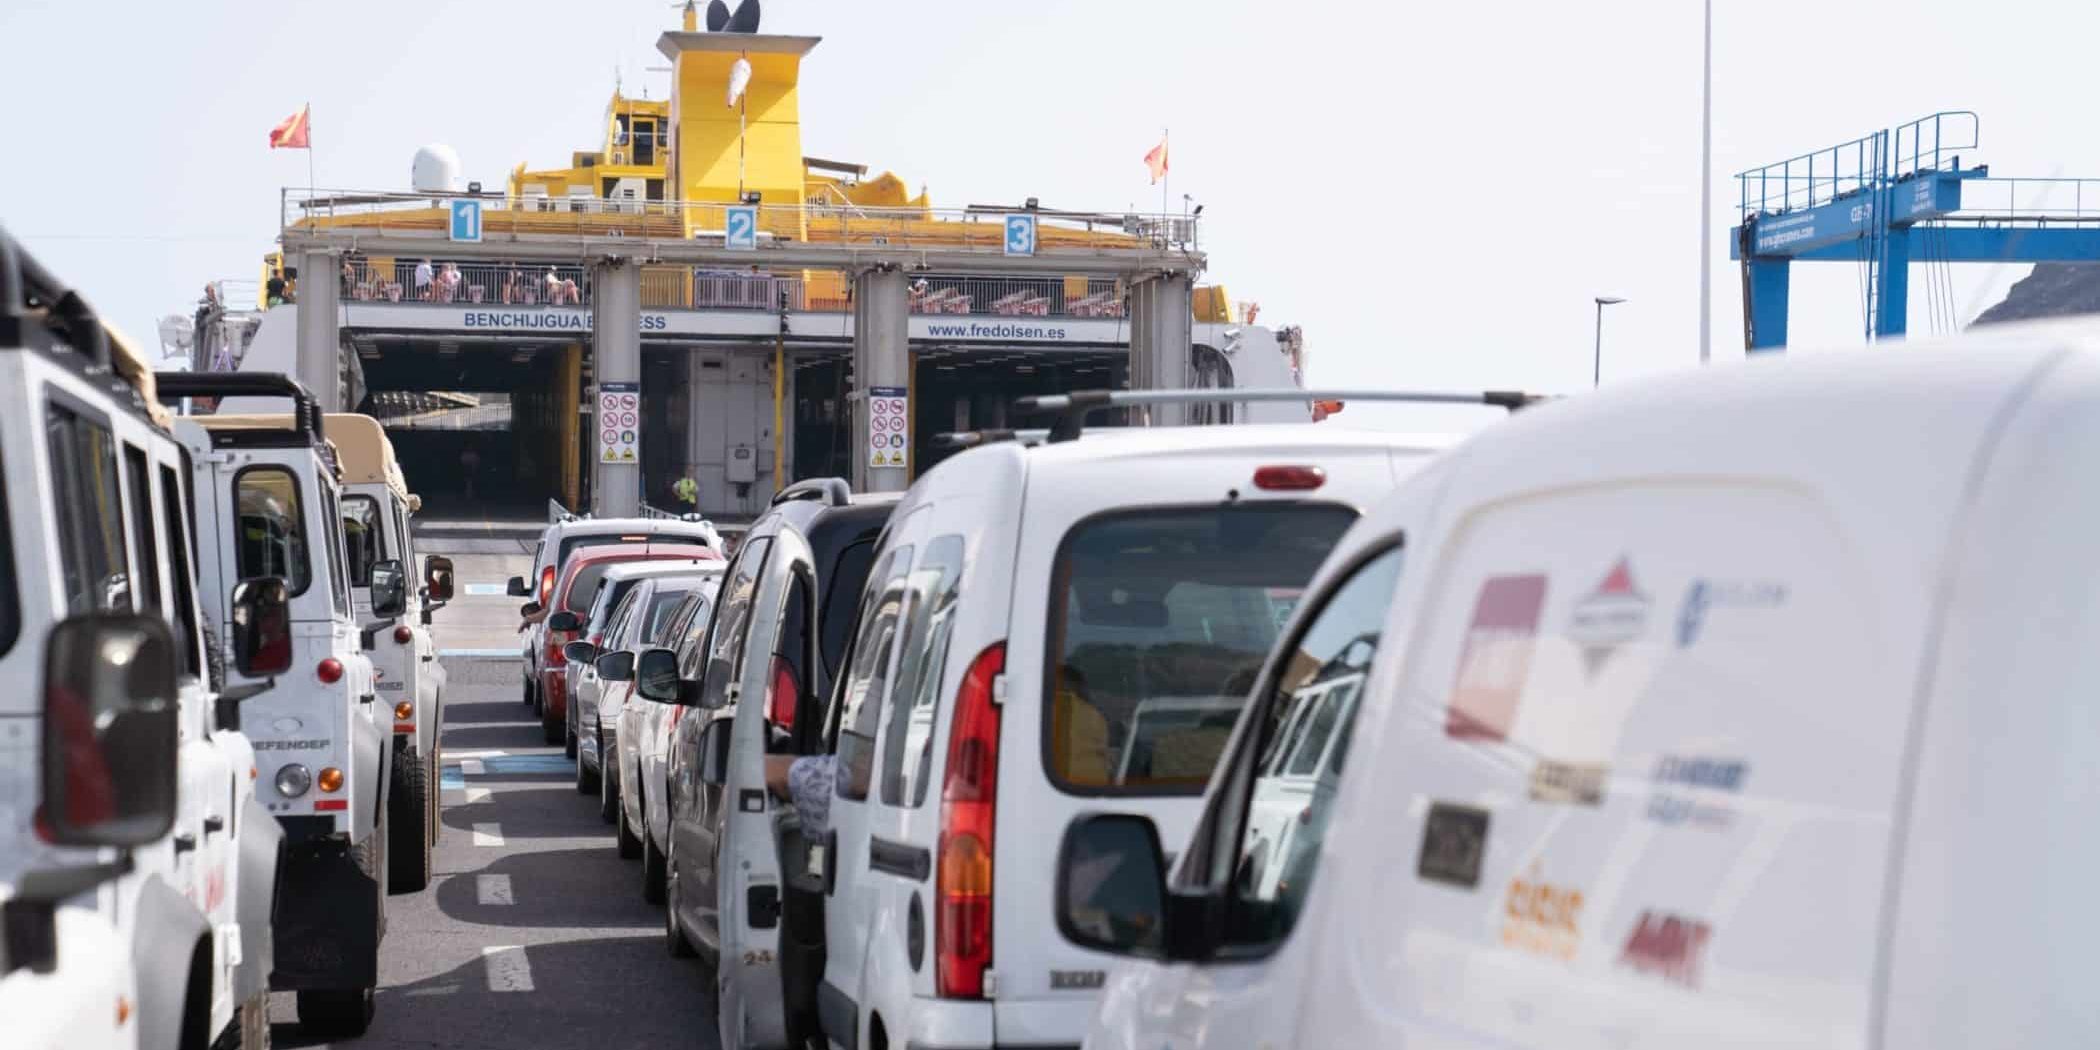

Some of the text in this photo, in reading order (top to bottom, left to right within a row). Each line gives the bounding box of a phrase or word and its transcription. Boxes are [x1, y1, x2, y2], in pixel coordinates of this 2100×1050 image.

[459, 204, 475, 236] 1
[731, 212, 751, 245] 2
[1010, 219, 1030, 251] 3
[464, 312, 581, 329] BENCHIJIGUA
[928, 323, 1065, 339] www.fredolsen.es
